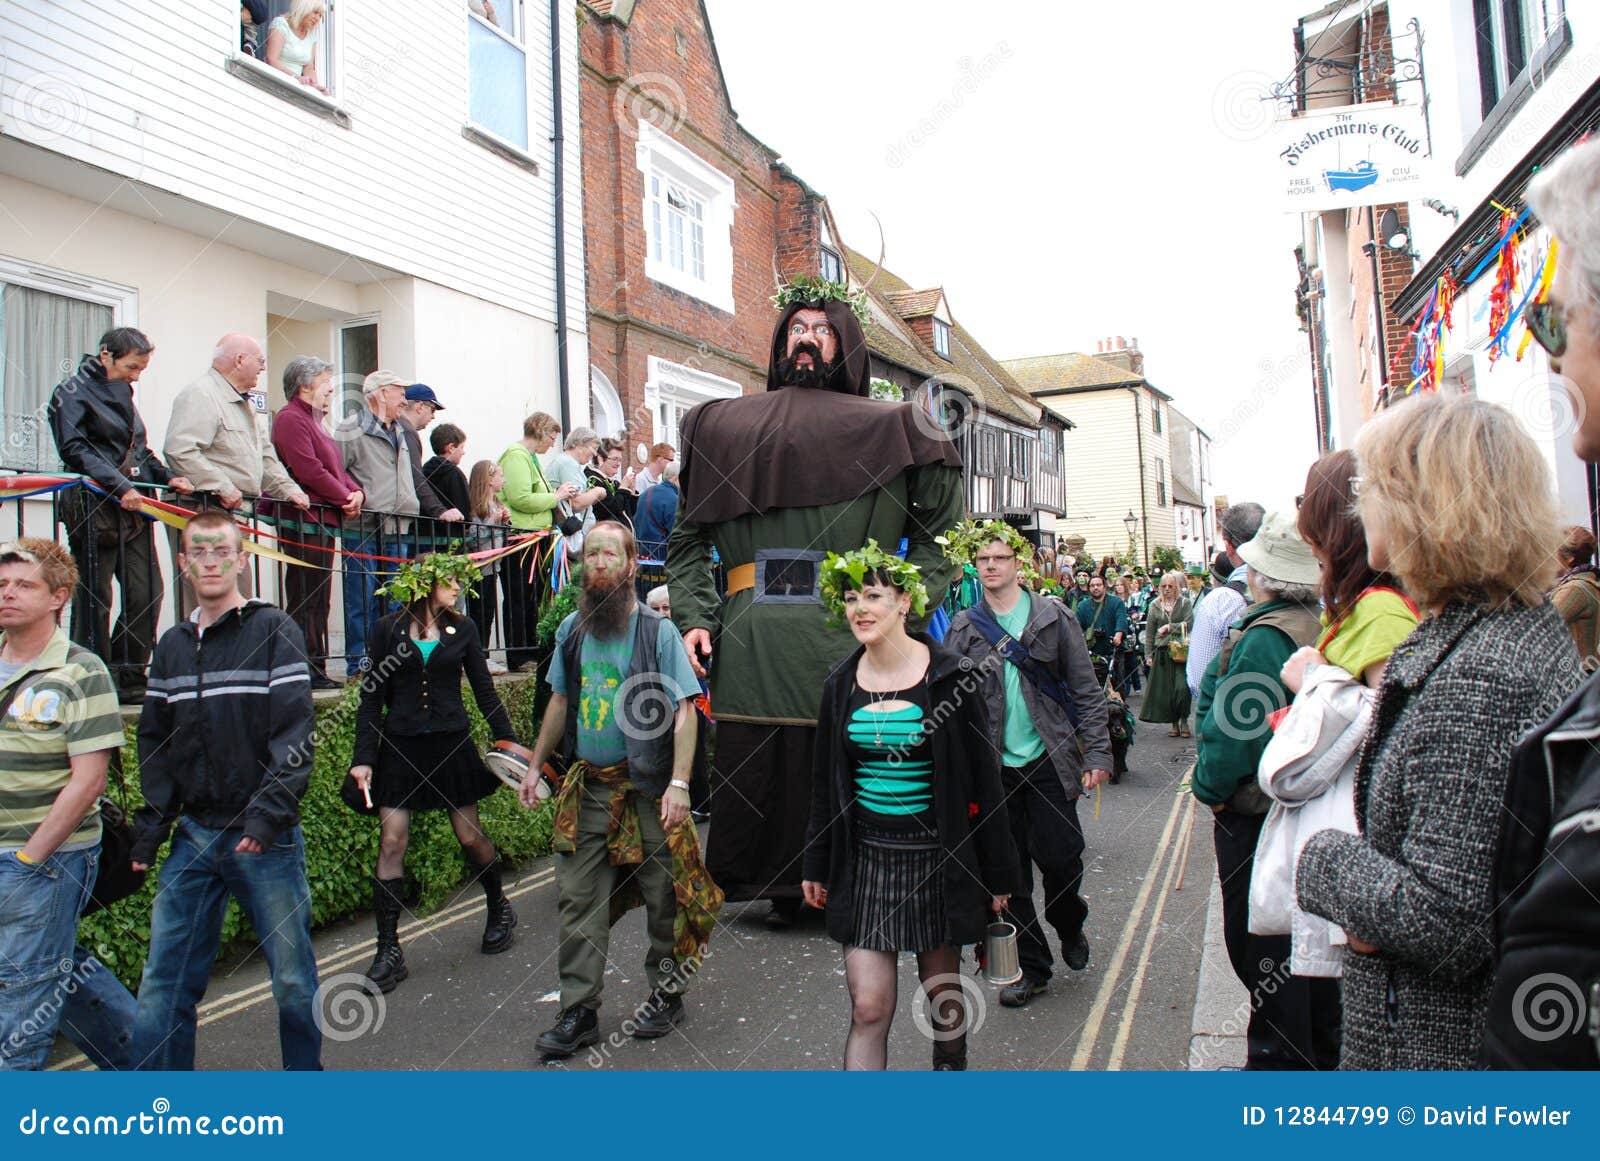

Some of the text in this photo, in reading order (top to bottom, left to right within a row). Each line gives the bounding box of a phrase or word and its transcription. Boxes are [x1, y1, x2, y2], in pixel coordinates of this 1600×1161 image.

[1335, 114, 1352, 123] The
[1279, 122, 1420, 167] Fishermen's Club
[1289, 177, 1311, 187] FREE
[1287, 186, 1316, 196] HOUSE
